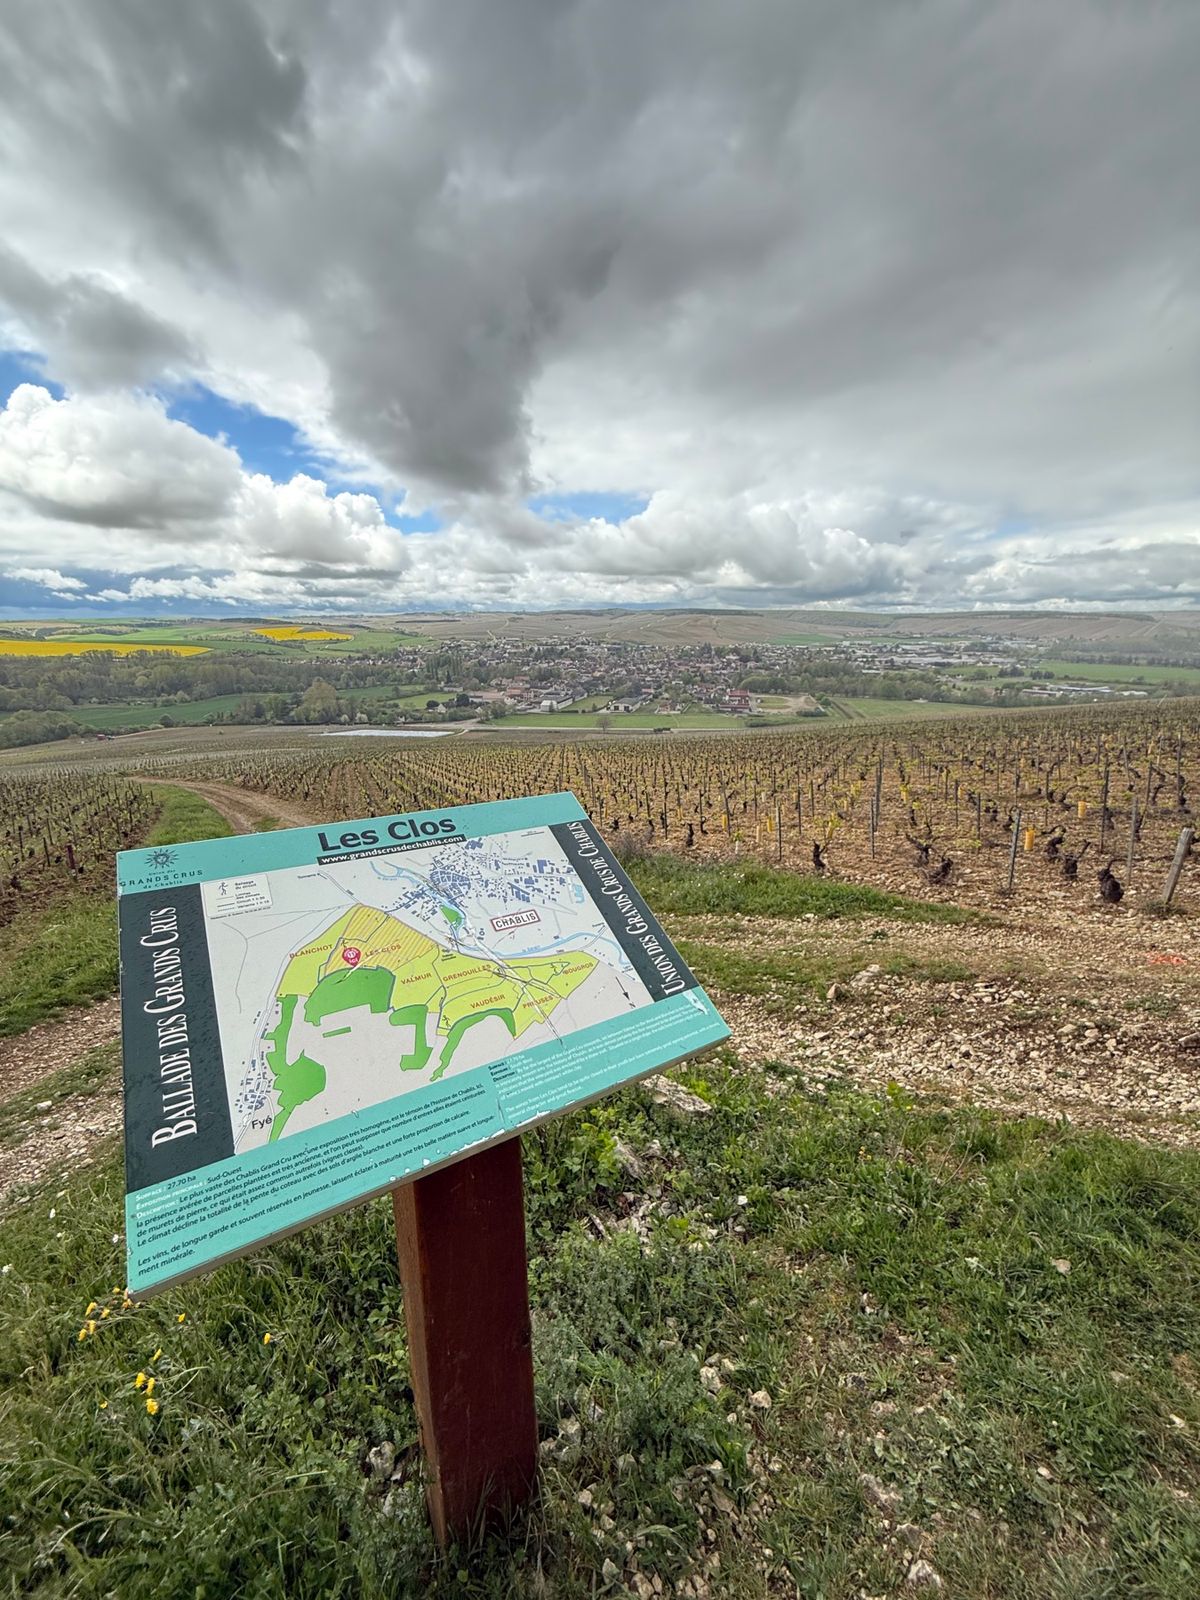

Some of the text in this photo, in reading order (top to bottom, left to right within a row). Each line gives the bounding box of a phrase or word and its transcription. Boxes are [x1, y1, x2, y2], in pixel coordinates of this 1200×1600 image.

[318, 818, 457, 852] Les Clos
[566, 822, 599, 857] CHABLIS
[321, 836, 463, 862] www.grandscrusdechablis.com
[589, 856, 608, 872] DE
[119, 870, 203, 887] GRANDS CRUS
[597, 869, 623, 895] CRUS
[495, 913, 536, 928] CHABLIS
[612, 893, 649, 935] GRANDS
[289, 944, 335, 960] BLANCHOT
[639, 934, 662, 954] DES
[401, 973, 432, 984] VALMUR
[651, 955, 685, 995] UNION
[470, 994, 505, 1009] VAUDÉSIR
[140, 906, 198, 1148] BALLADE DES GRANDS CRUS
[251, 1115, 274, 1129] Fyé
[144, 1209, 178, 1226] présence
[213, 1184, 243, 1200] parcelles
[243, 1173, 271, 1188] plantées
[341, 1140, 355, 1150] peut
[356, 1130, 380, 1143] supposer
[392, 1118, 412, 1128] nombre
[189, 1190, 204, 1201] plus
[205, 1183, 222, 1193] vaste
[236, 1169, 260, 1181] Chablis
[260, 1160, 280, 1171] Grand
[293, 1151, 306, 1159] avec
[319, 1135, 349, 1149] exposition
[207, 1167, 242, 1184] Sud-Ouest
[148, 1229, 171, 1242] climat
[172, 1219, 198, 1233] décline
[207, 1205, 232, 1219] totalité
[250, 1191, 269, 1203] pente
[280, 1178, 302, 1190] coteau
[303, 1172, 316, 1181] avec
[363, 1144, 384, 1156] blanche
[416, 1121, 443, 1136] proportion
[167, 1178, 187, 1190] 27.70
[138, 1257, 151, 1266] Les
[152, 1250, 169, 1260] vins,
[182, 1234, 207, 1248] longue
[209, 1225, 229, 1239] garde
[238, 1209, 266, 1225] souvent
[266, 1199, 293, 1213] réservés
[331, 1173, 353, 1186] laissent
[354, 1165, 373, 1176] éclater
[378, 1153, 402, 1166] maturité
[424, 1139, 436, 1147] belle
[457, 1125, 470, 1133] suave
[148, 1219, 174, 1233] murets
[186, 1206, 209, 1219] pierre,
[219, 1197, 230, 1205] qui
[231, 1190, 246, 1200] était
[248, 1184, 264, 1194] assez
[266, 1173, 294, 1186] commun
[295, 1162, 321, 1175] autrefois
[138, 1249, 195, 1276] ment minérale.
